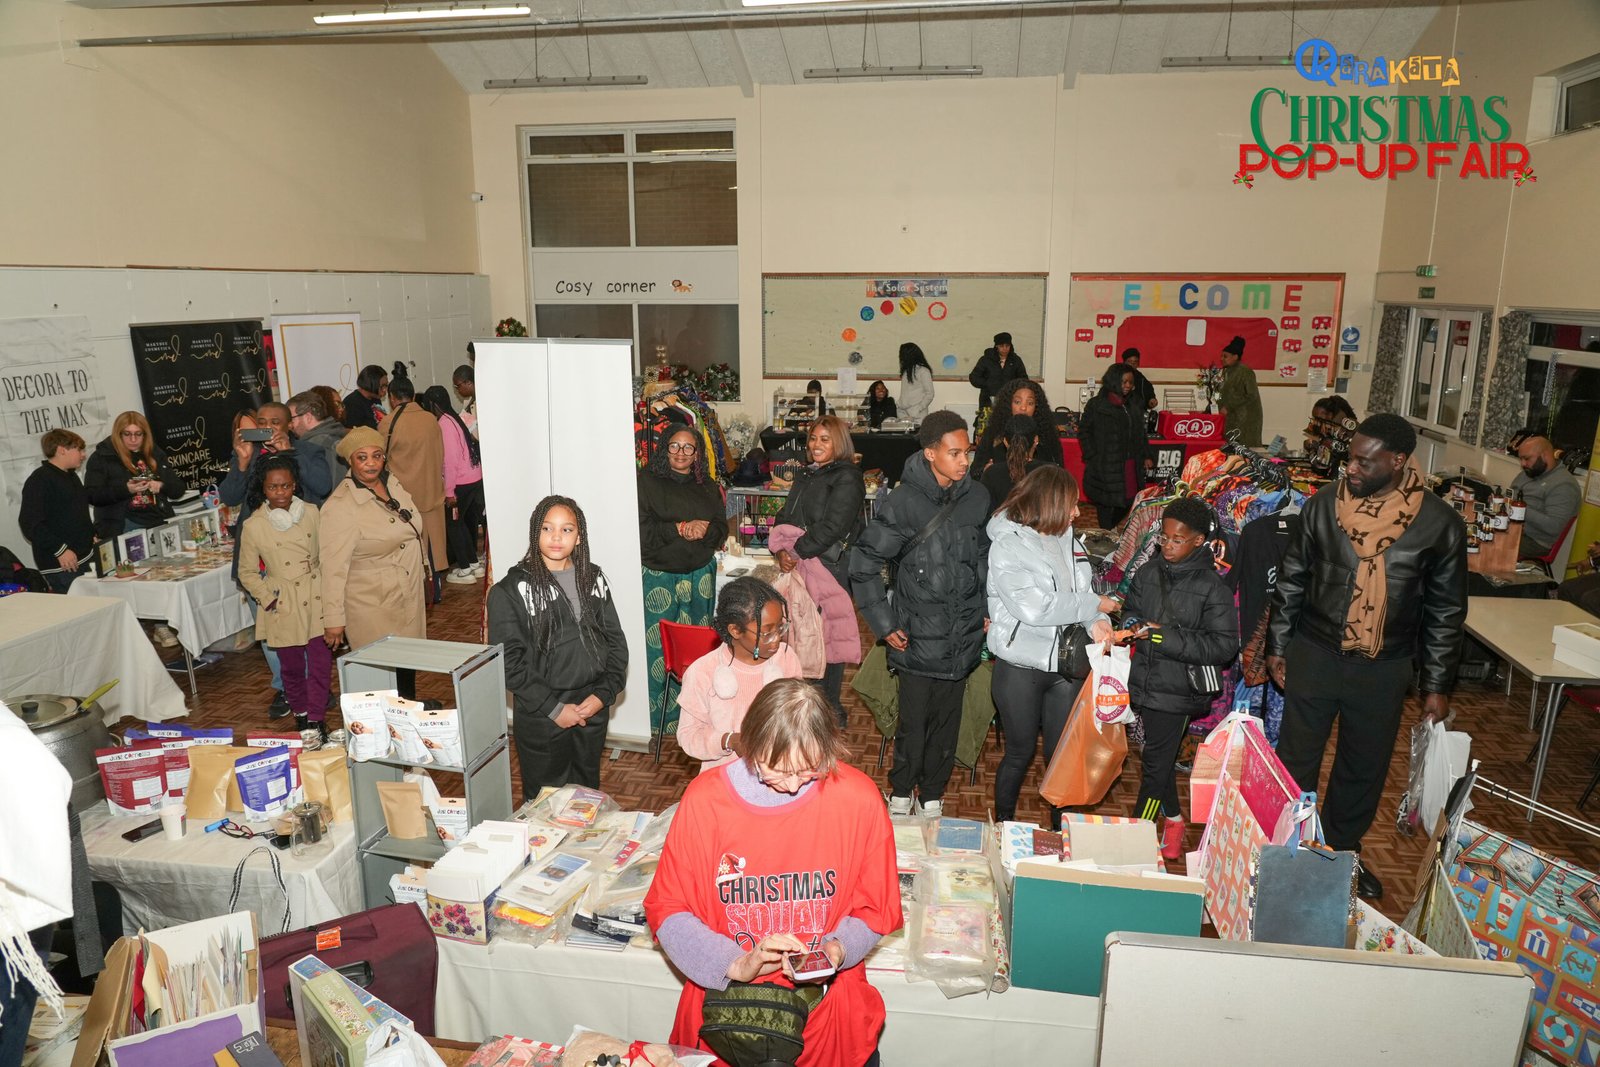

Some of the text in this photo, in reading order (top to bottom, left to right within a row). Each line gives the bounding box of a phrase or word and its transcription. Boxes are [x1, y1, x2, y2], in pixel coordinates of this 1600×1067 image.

[555, 280, 656, 296] Cosy corner
[886, 283, 911, 292] Solar
[913, 283, 948, 296] System
[1084, 282, 1303, 312] WELCOME
[1, 369, 88, 402] DECORA TO
[20, 402, 88, 435] THE MAX
[1176, 421, 1213, 434] RAP
[167, 448, 212, 468] SKINCARE
[718, 869, 837, 905] CHRISTMAS
